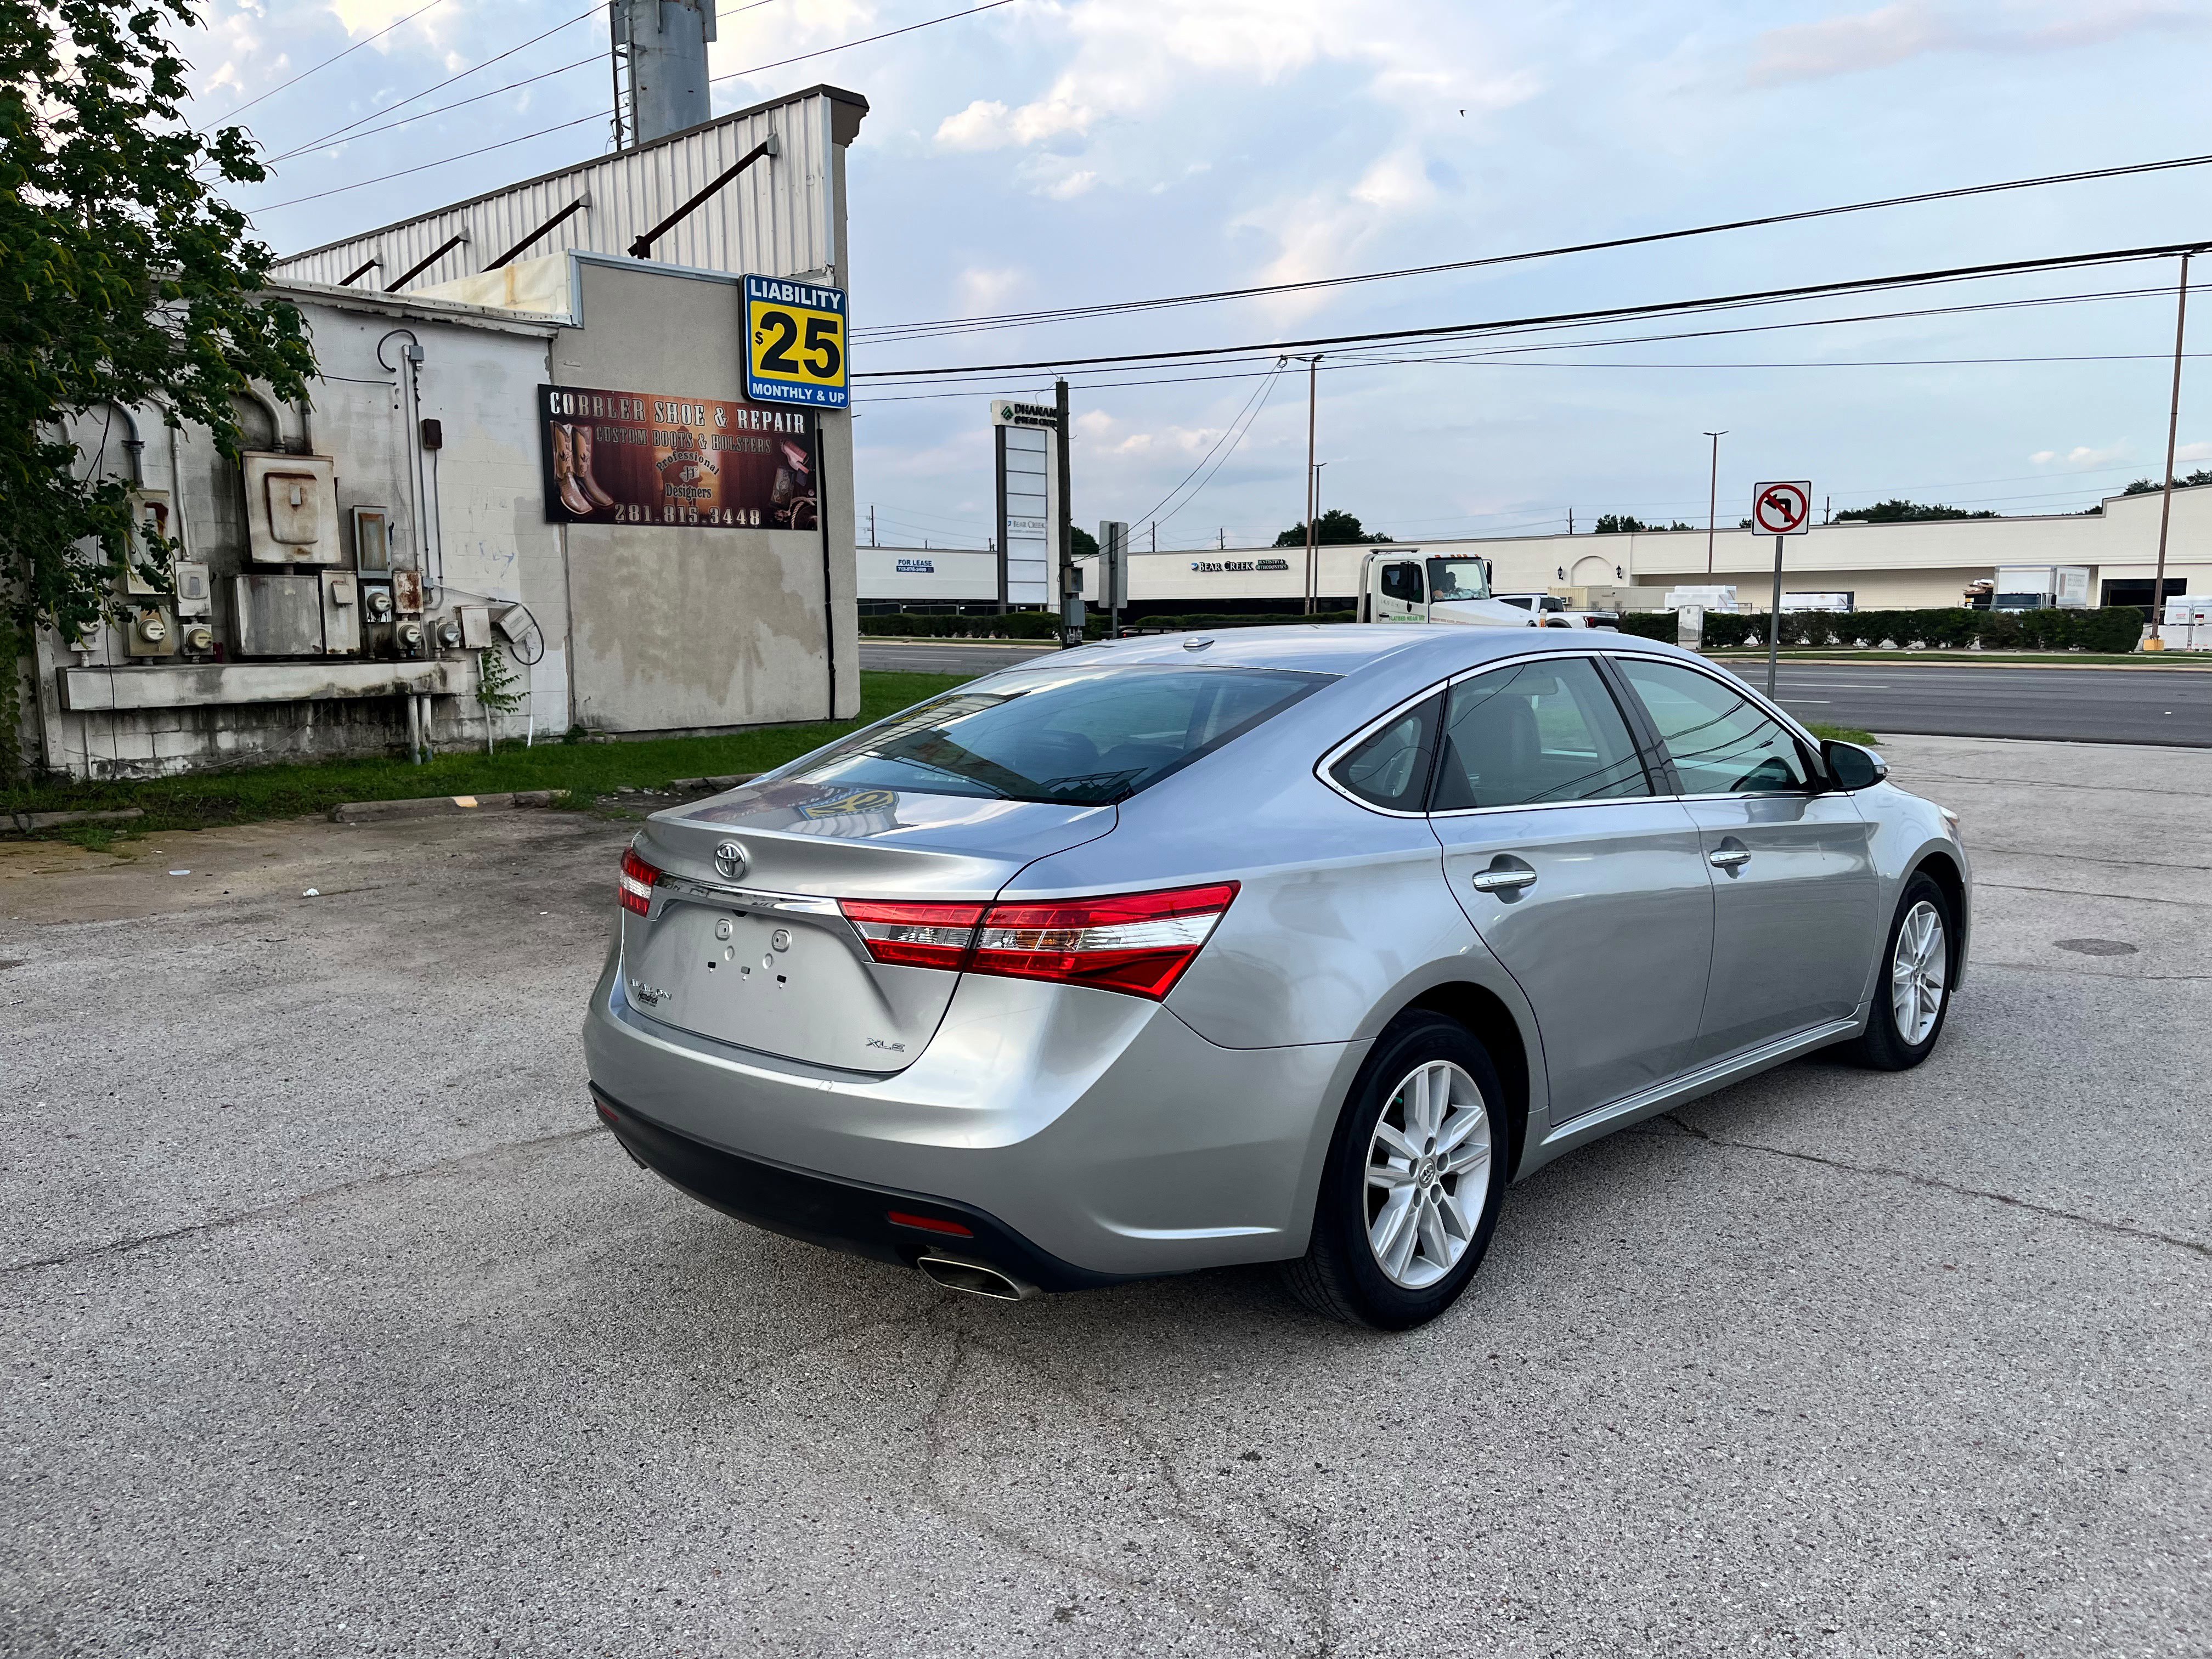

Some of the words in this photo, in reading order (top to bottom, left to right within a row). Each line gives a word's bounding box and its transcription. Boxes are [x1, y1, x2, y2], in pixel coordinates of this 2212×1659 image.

[751, 279, 841, 309] LIABILITY
[753, 382, 812, 400] MONTHLY
[817, 390, 825, 401] &
[829, 391, 845, 403] UP
[550, 392, 646, 421] COBBLER
[654, 401, 705, 426] SHOE
[714, 407, 727, 428] &
[737, 409, 805, 434] REPAIR
[596, 425, 647, 445] CUSTOM
[653, 430, 693, 448] BOOTS
[698, 433, 707, 449] &
[712, 435, 771, 453] HOLSTERS
[656, 452, 720, 475] Professional
[665, 483, 712, 501] Designers
[614, 504, 761, 526] 281.815.3448
[1199, 561, 1222, 572] BEAR
[1224, 561, 1254, 571] CREEK
[865, 1037, 905, 1052] XLE
